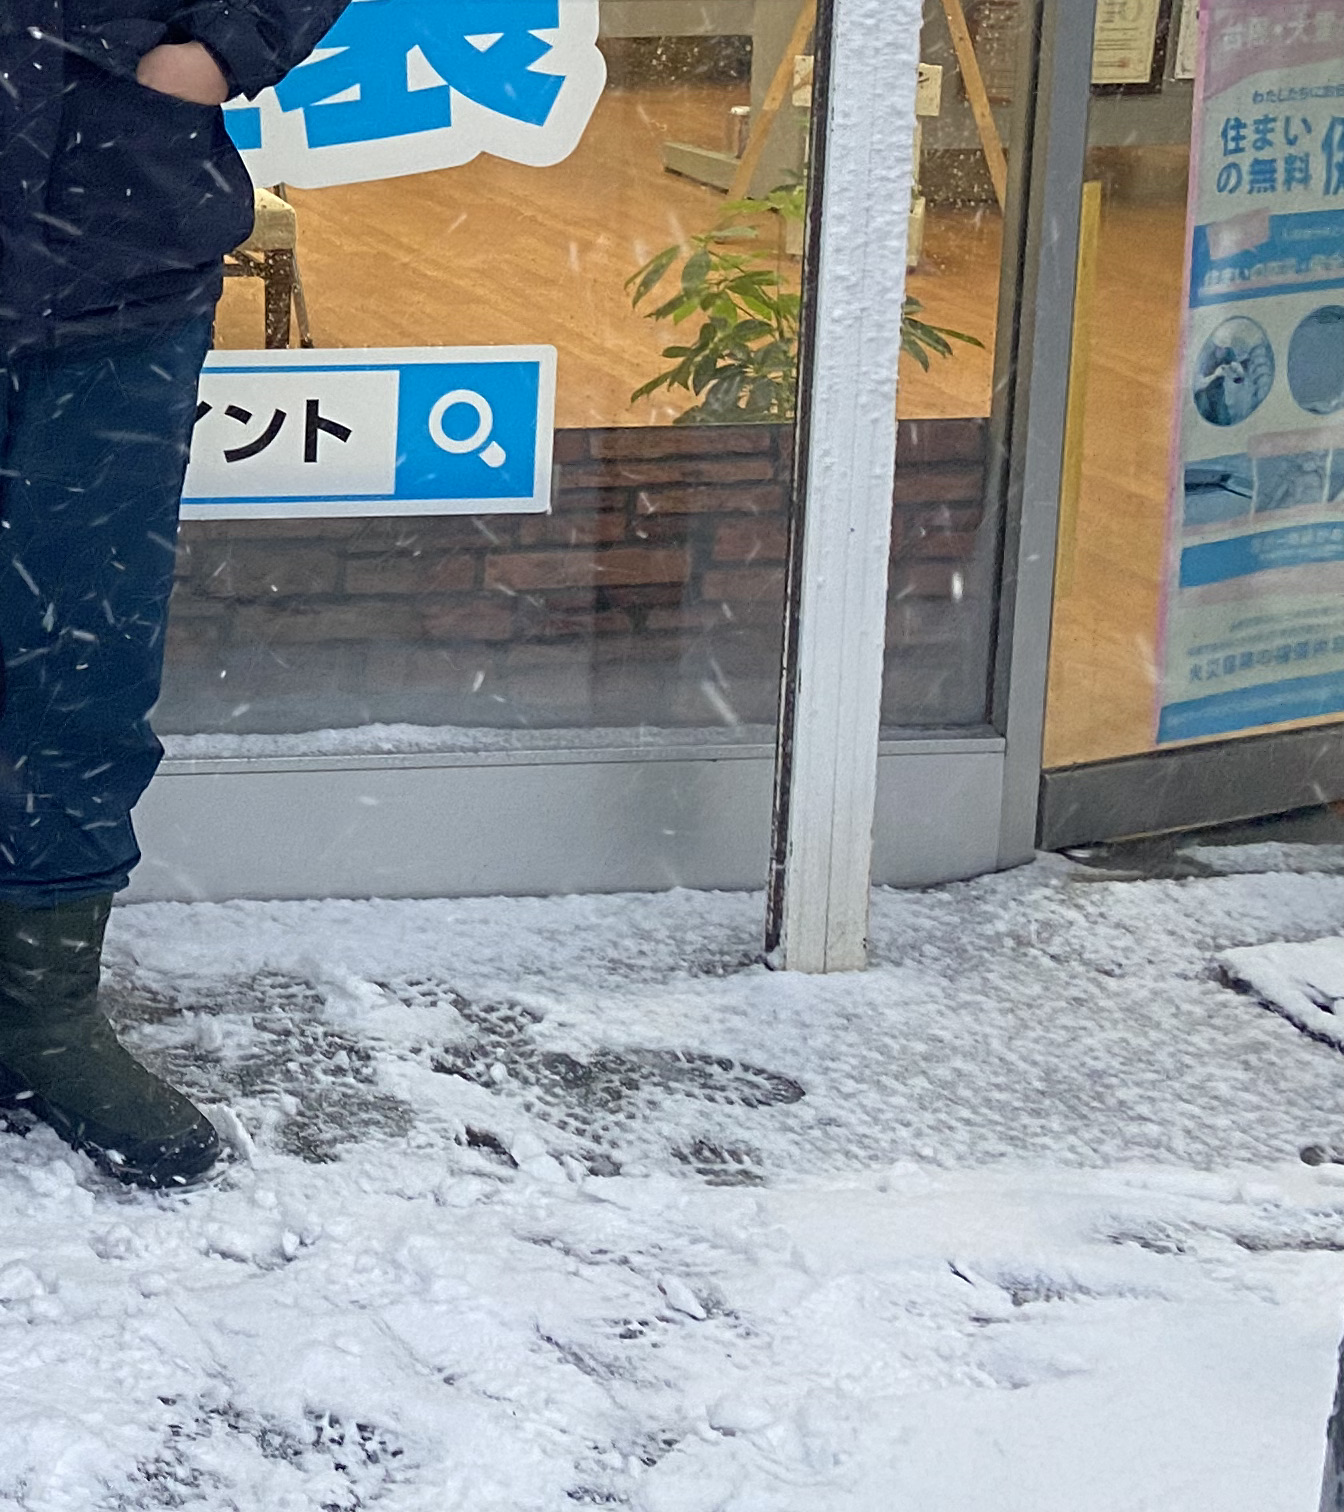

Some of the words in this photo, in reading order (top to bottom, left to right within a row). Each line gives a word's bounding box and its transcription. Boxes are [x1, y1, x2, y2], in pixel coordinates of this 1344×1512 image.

[1221, 113, 1313, 157] 住まい
[1216, 152, 1313, 195] の無料
